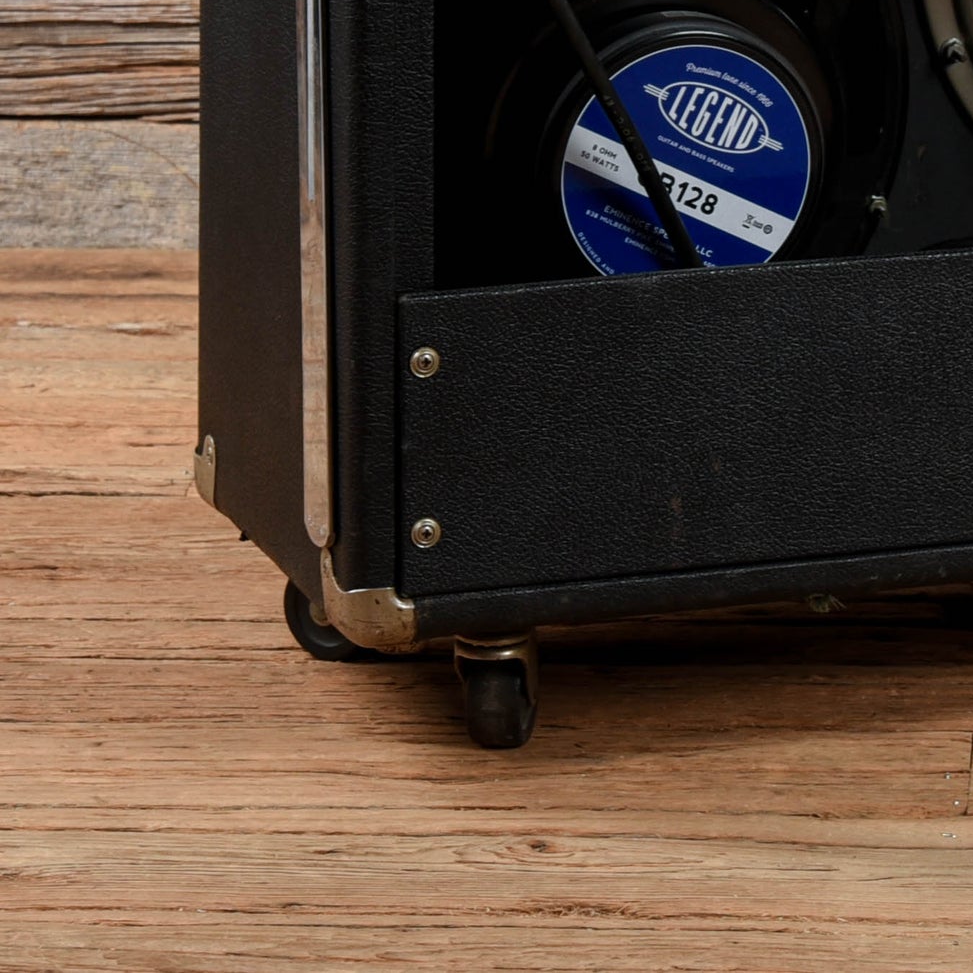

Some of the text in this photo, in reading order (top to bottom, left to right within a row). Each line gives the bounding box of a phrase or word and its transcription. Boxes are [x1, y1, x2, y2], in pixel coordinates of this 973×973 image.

[685, 62, 722, 79] Premium
[738, 80, 757, 96] since
[668, 86, 760, 151] LEGEND
[580, 150, 621, 173] 50 WATTS
[592, 144, 619, 160] 8 OHM
[657, 134, 736, 173] GUITAR AND BASS SPEAKERS
[577, 231, 615, 275] DESIGNED AND
